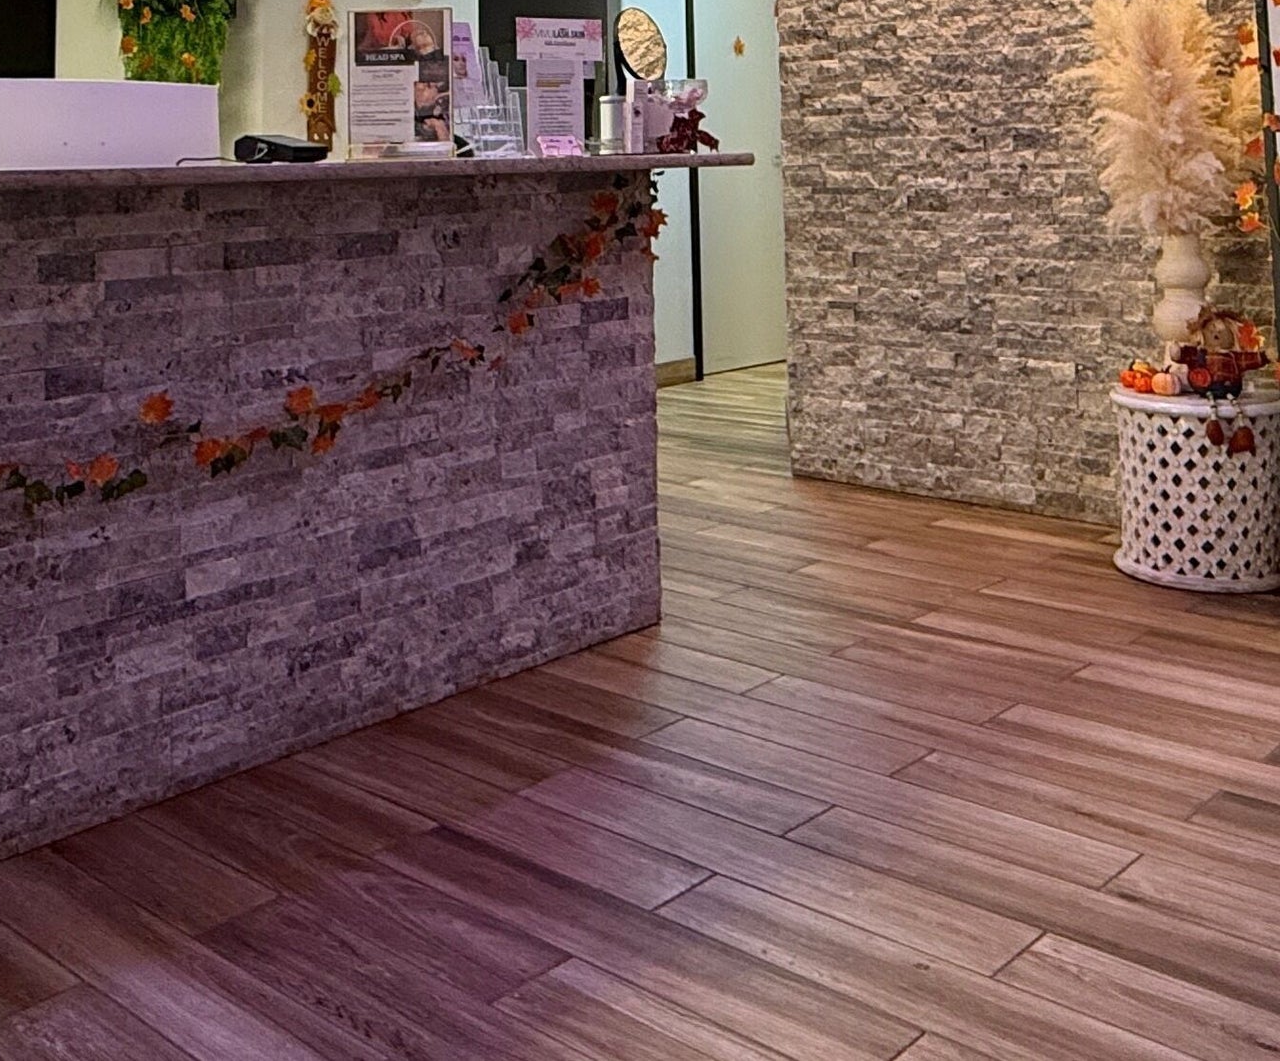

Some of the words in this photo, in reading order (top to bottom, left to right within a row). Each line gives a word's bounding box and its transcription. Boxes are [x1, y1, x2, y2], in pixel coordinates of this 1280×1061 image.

[316, 36, 330, 114] WELCOME
[365, 53, 389, 62] HEAD
[390, 53, 406, 61] SPA
